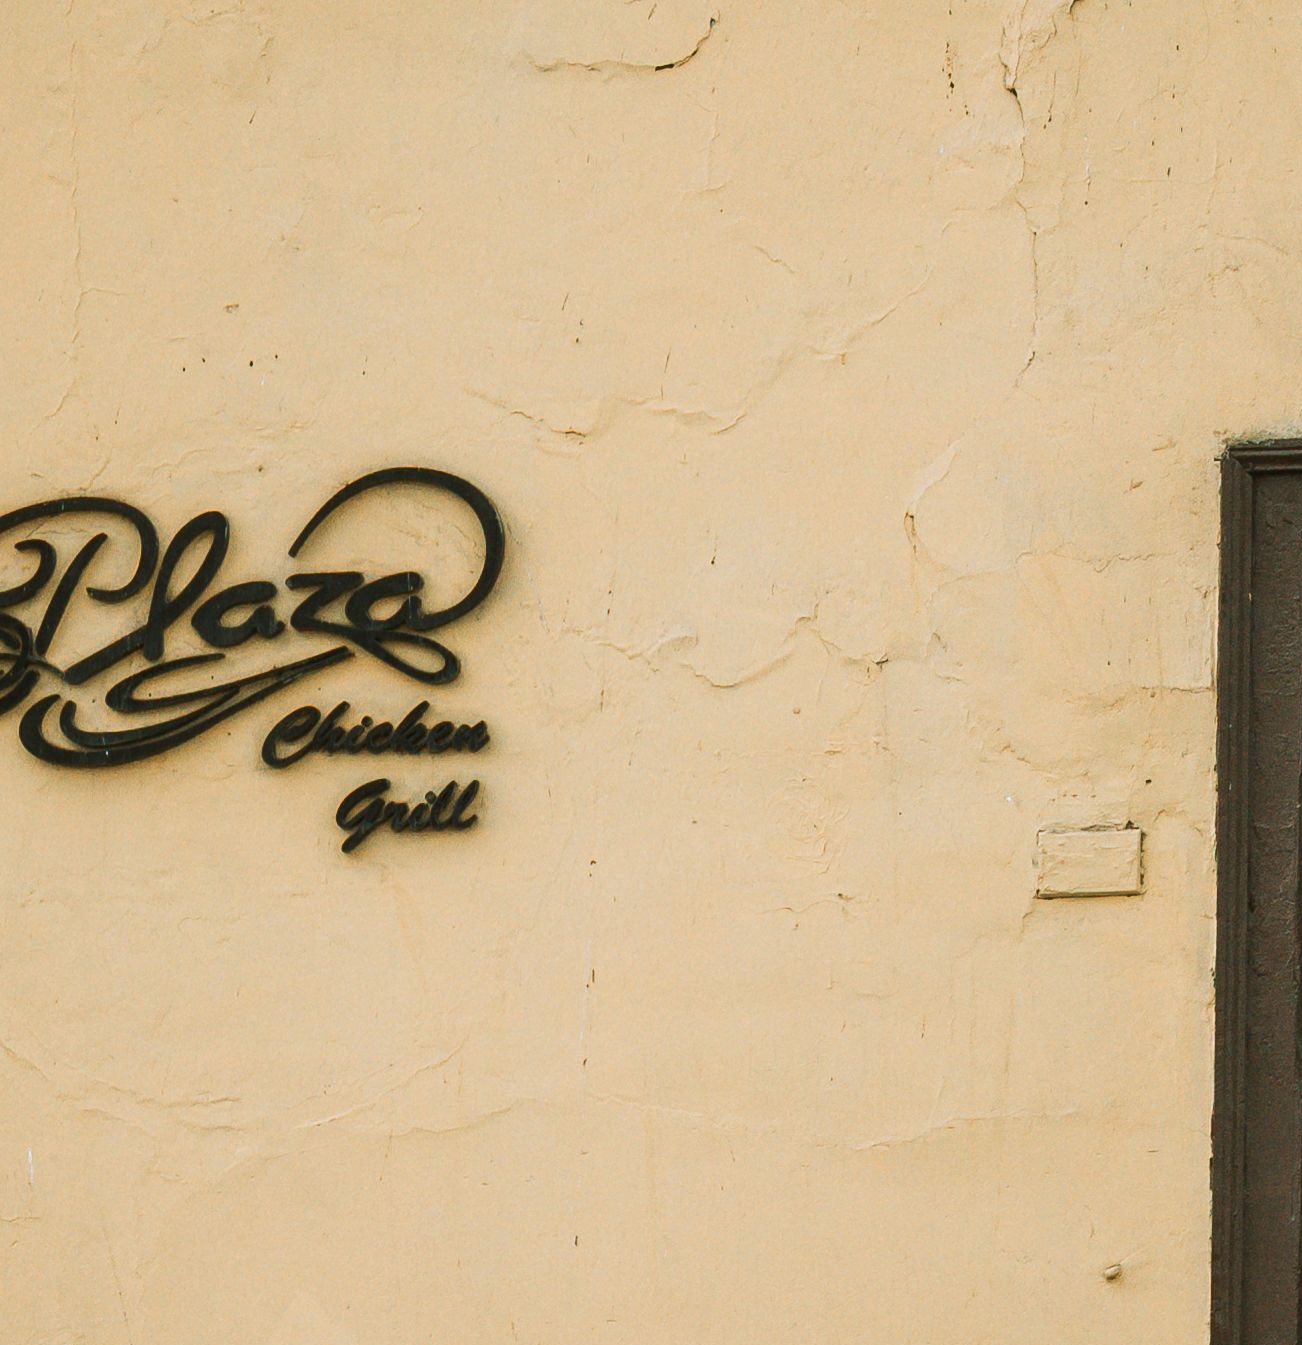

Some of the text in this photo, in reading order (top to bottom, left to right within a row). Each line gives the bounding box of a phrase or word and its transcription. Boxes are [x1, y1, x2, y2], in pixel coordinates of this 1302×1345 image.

[0, 467, 506, 768] Plaza
[260, 700, 491, 769] Chicken
[334, 777, 481, 853] Grill
